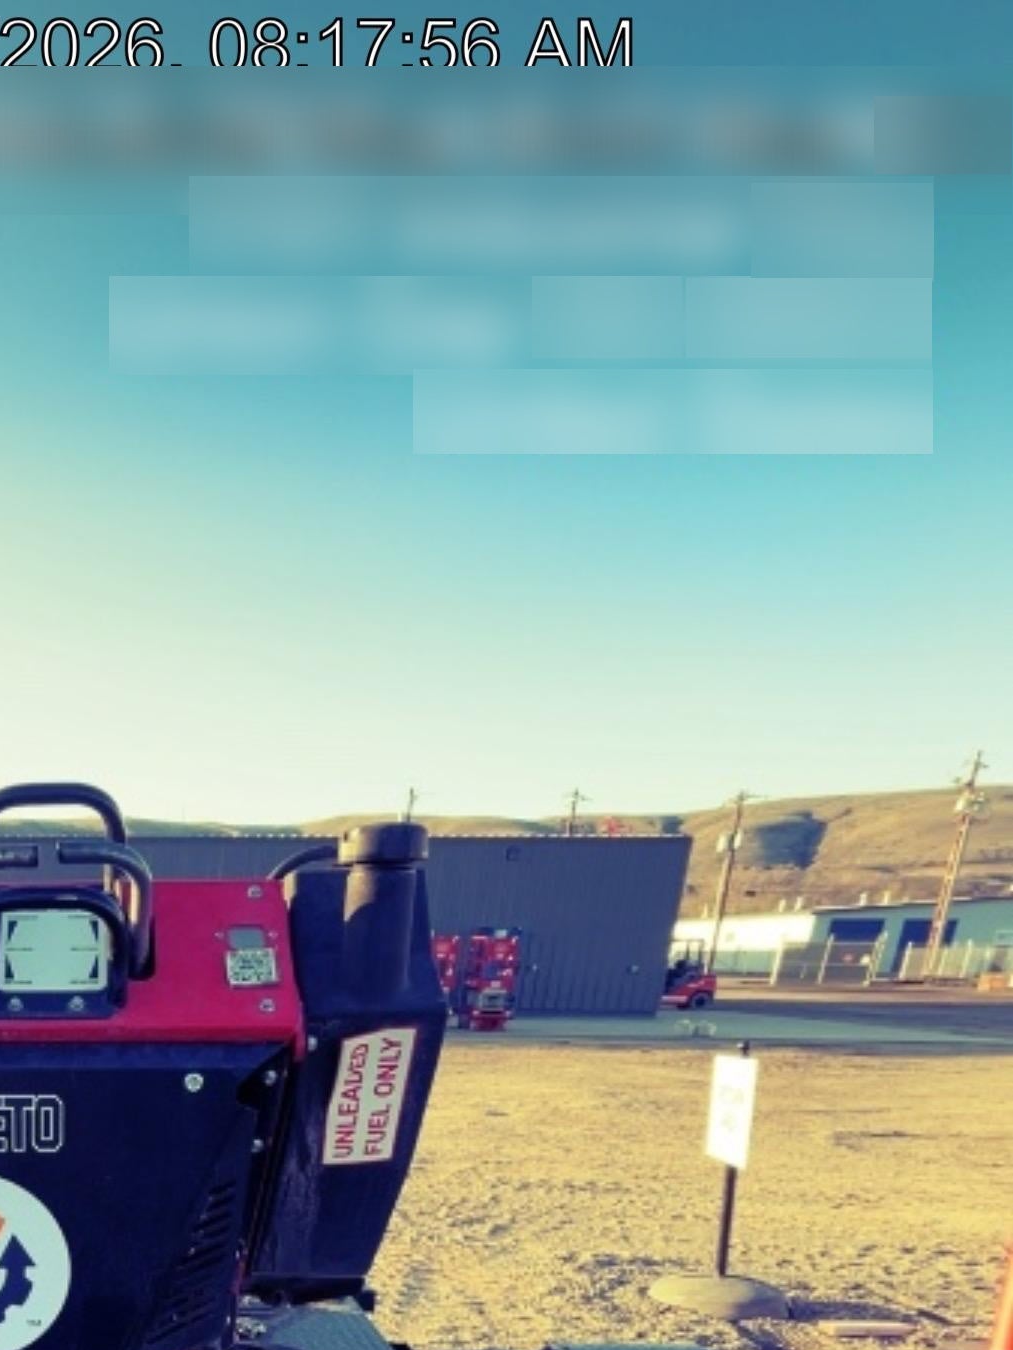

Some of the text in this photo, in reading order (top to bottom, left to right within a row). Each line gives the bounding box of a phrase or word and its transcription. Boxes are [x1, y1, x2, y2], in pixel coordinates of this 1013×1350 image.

[331, 1042, 369, 1159] UNLEADED
[363, 1037, 402, 1156] FUEL ONLY
